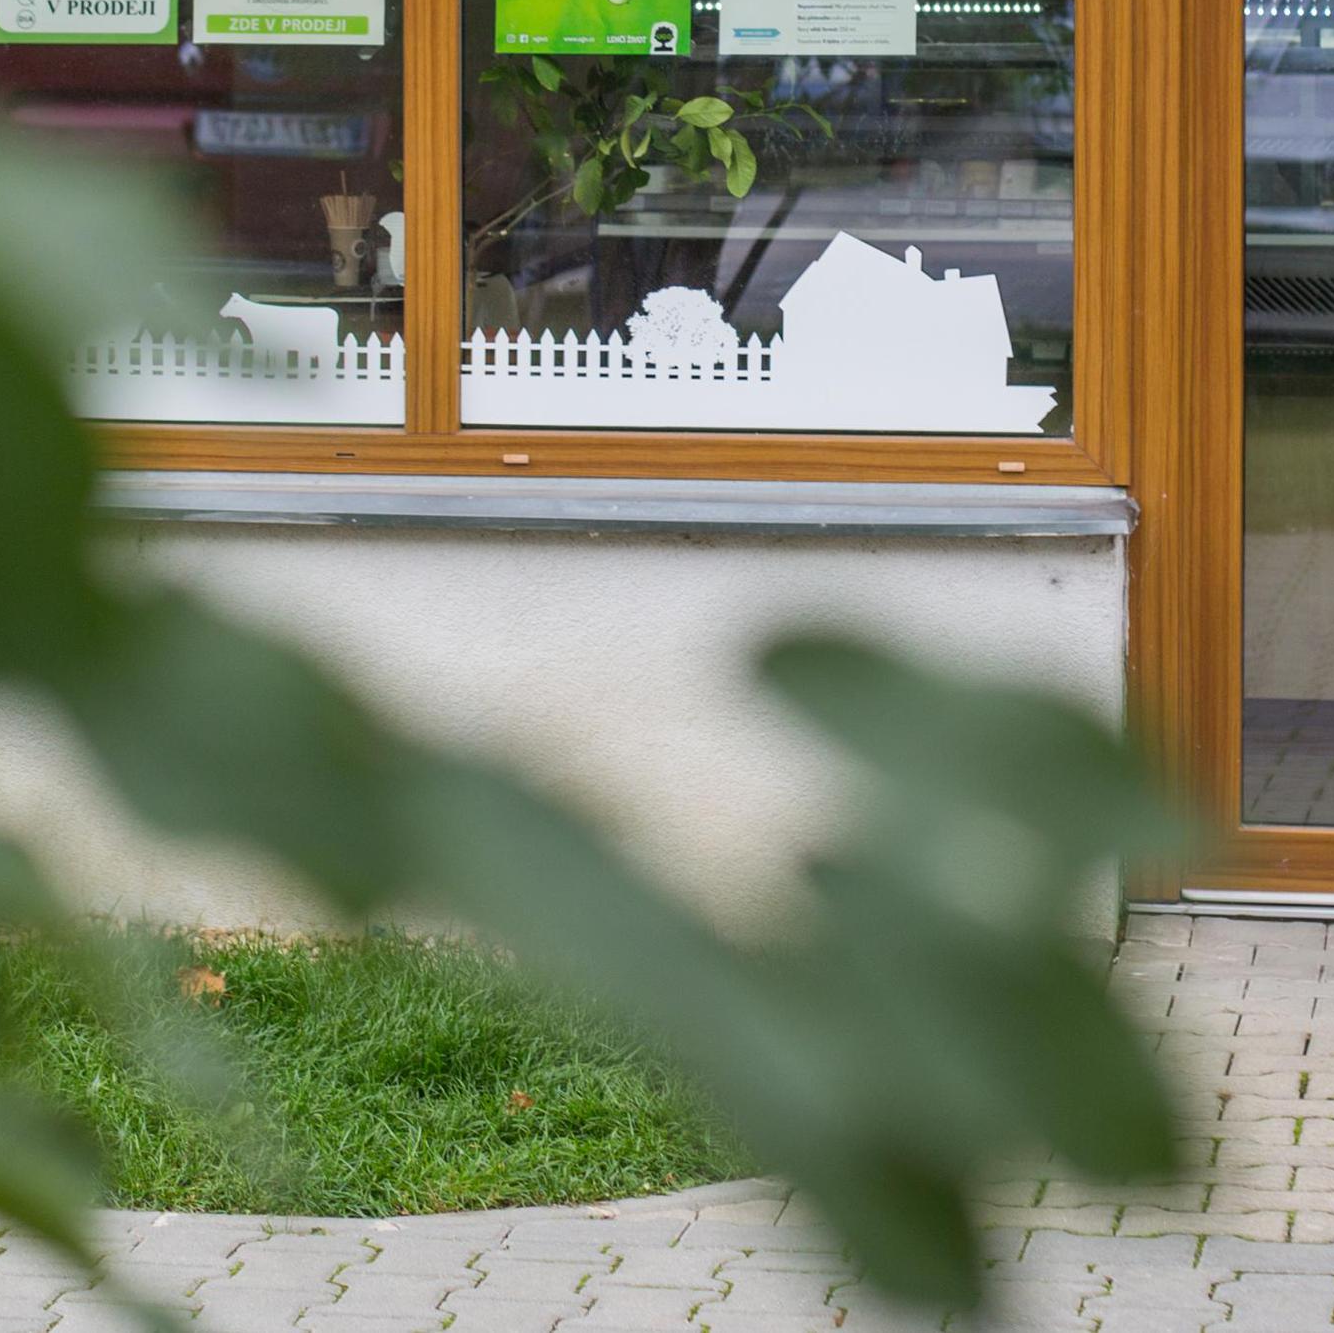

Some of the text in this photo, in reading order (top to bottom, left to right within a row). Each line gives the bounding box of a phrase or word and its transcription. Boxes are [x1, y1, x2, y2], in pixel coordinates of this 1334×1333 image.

[47, 0, 155, 15] V PRODEJI
[229, 18, 347, 32] ZDE V PRODEJI
